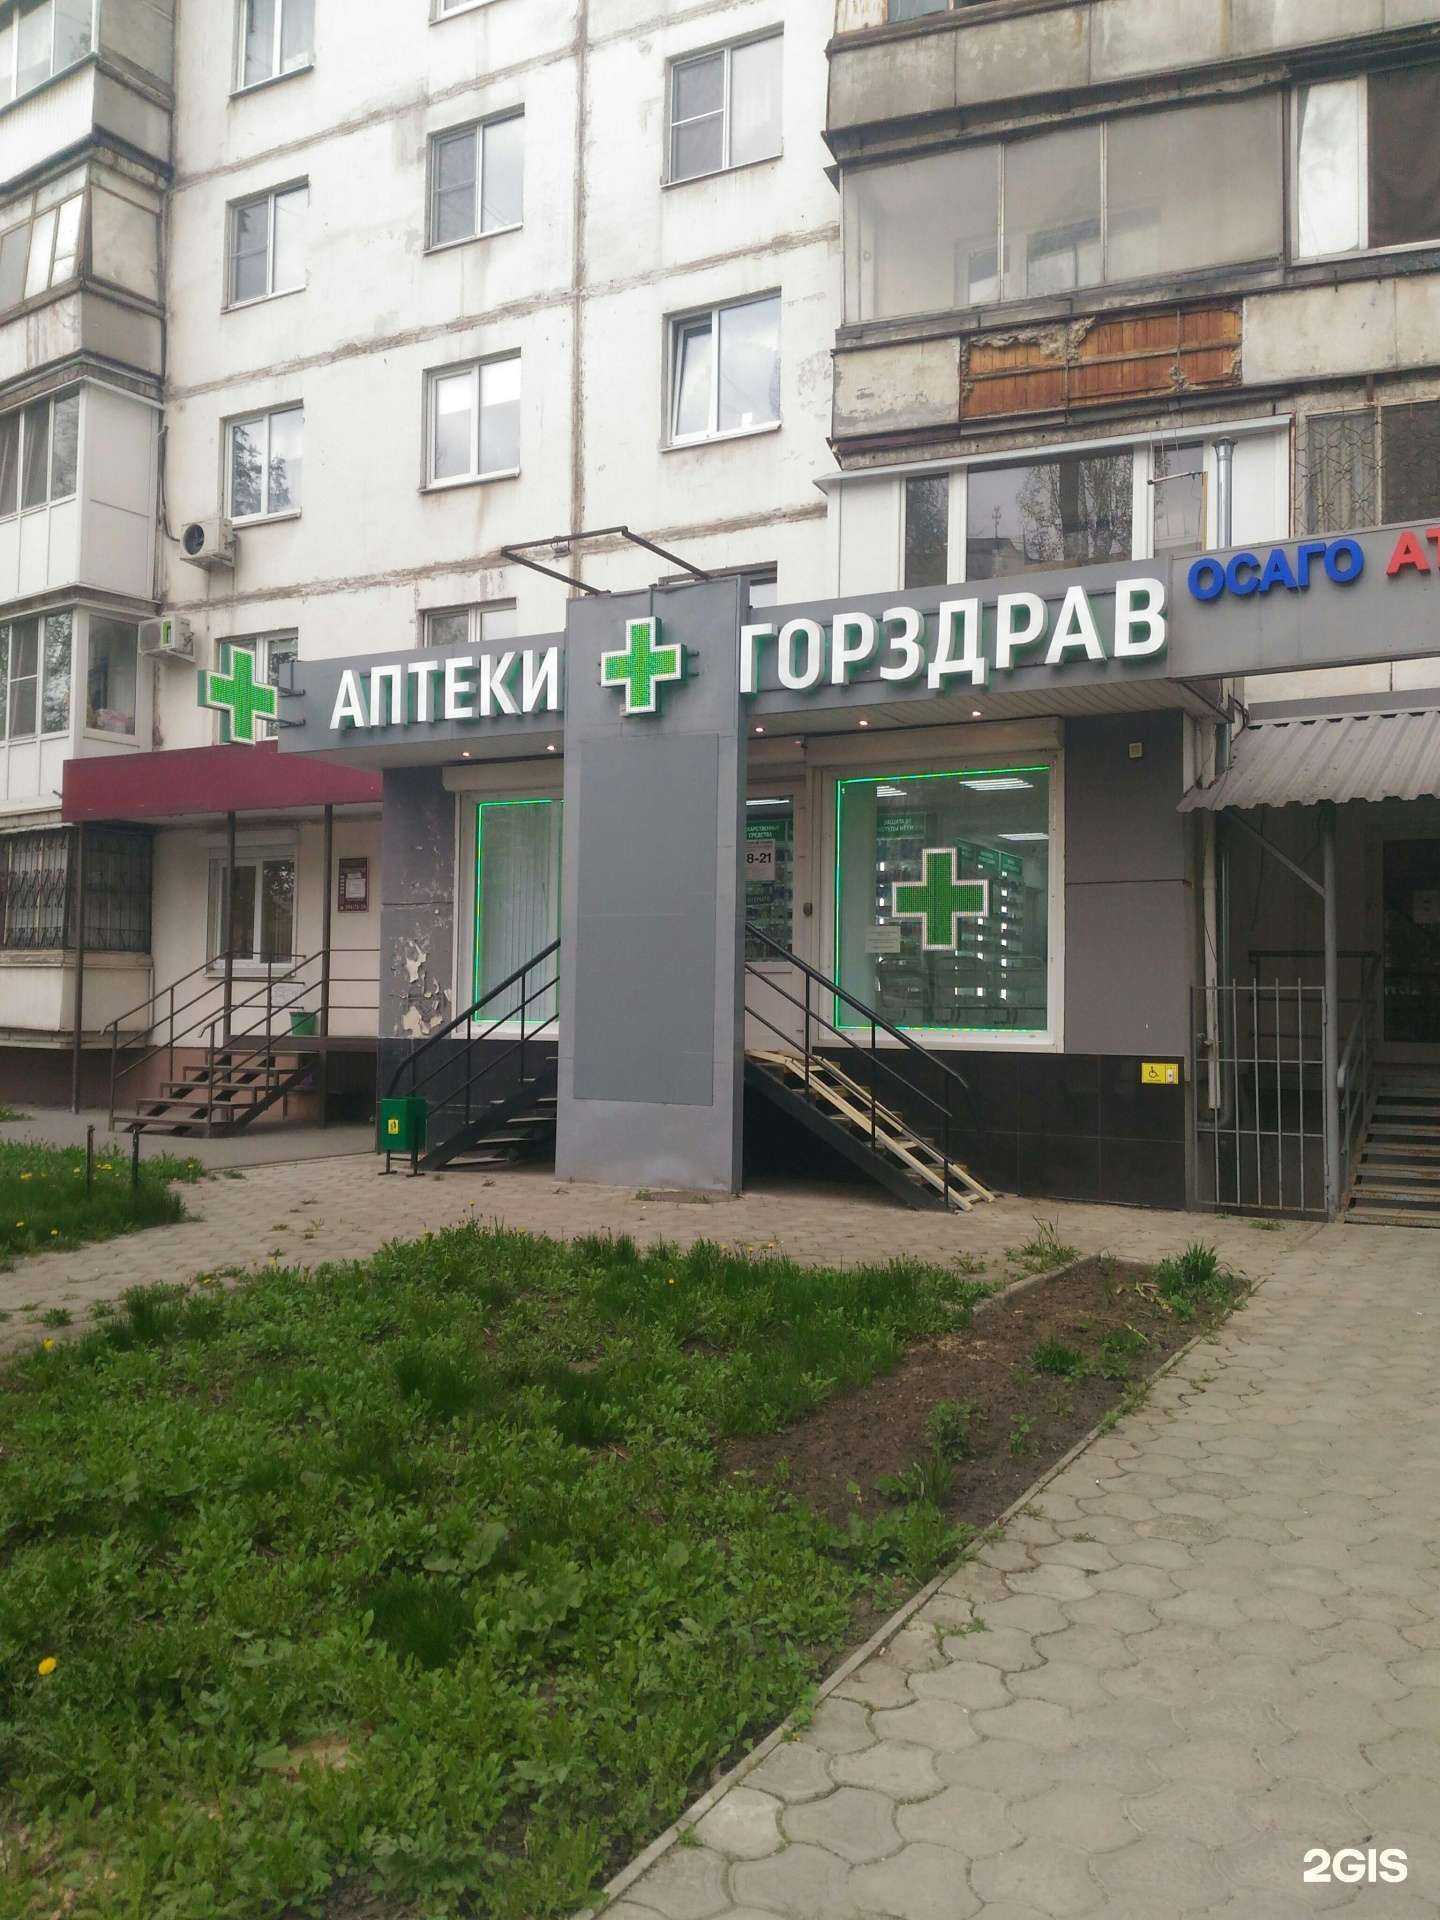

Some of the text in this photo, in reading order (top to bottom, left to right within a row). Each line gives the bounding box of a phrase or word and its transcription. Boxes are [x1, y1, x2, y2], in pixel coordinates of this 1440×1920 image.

[1188, 538, 1364, 602] ОСАГО
[329, 577, 1168, 730] АПТЕКИ ГОРЗДРАВ
[746, 853, 771, 864] 8-21
